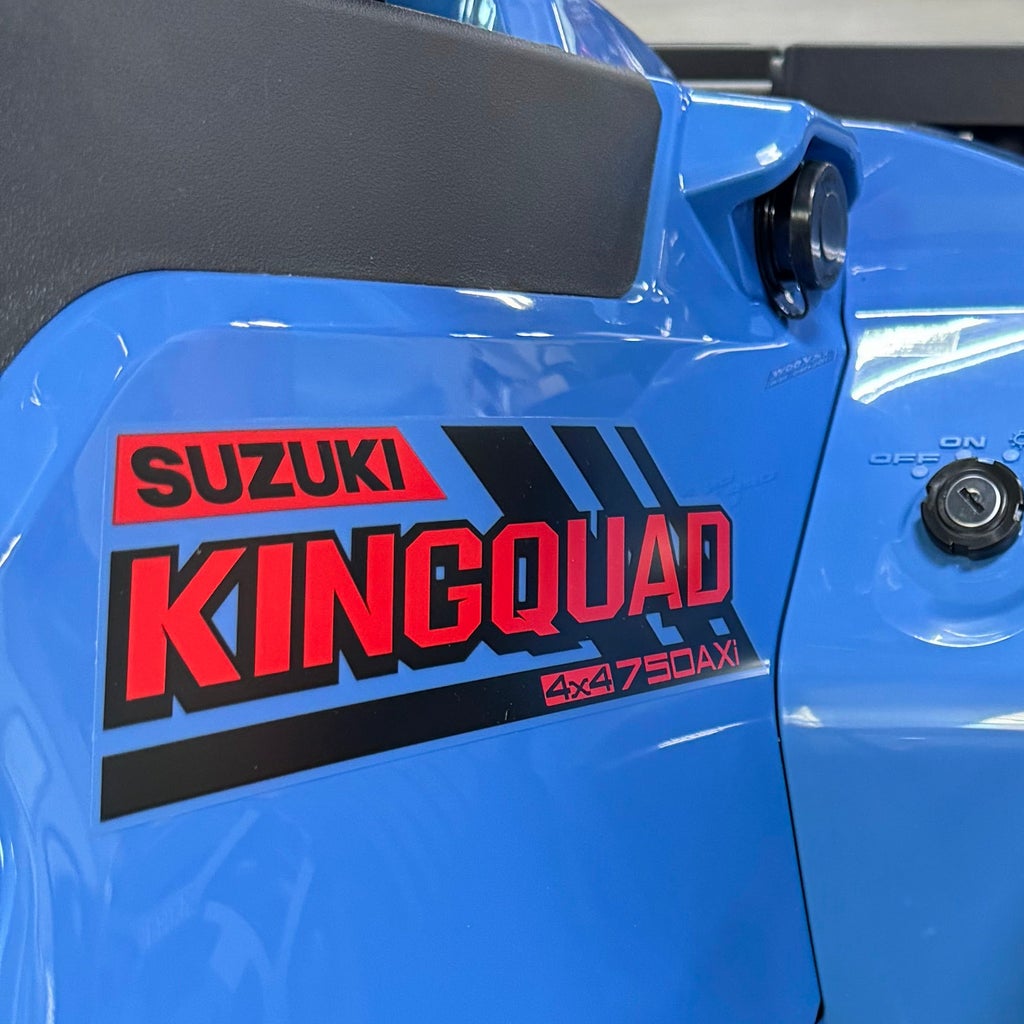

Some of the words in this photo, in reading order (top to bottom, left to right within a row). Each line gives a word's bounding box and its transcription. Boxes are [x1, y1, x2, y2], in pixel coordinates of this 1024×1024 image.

[130, 437, 407, 507] SUZUKI
[869, 452, 940, 465] OFF
[939, 435, 986, 448] ON
[125, 509, 733, 703] KINGQUAD
[546, 665, 613, 701] 4x4
[616, 639, 740, 691] 750AXi
